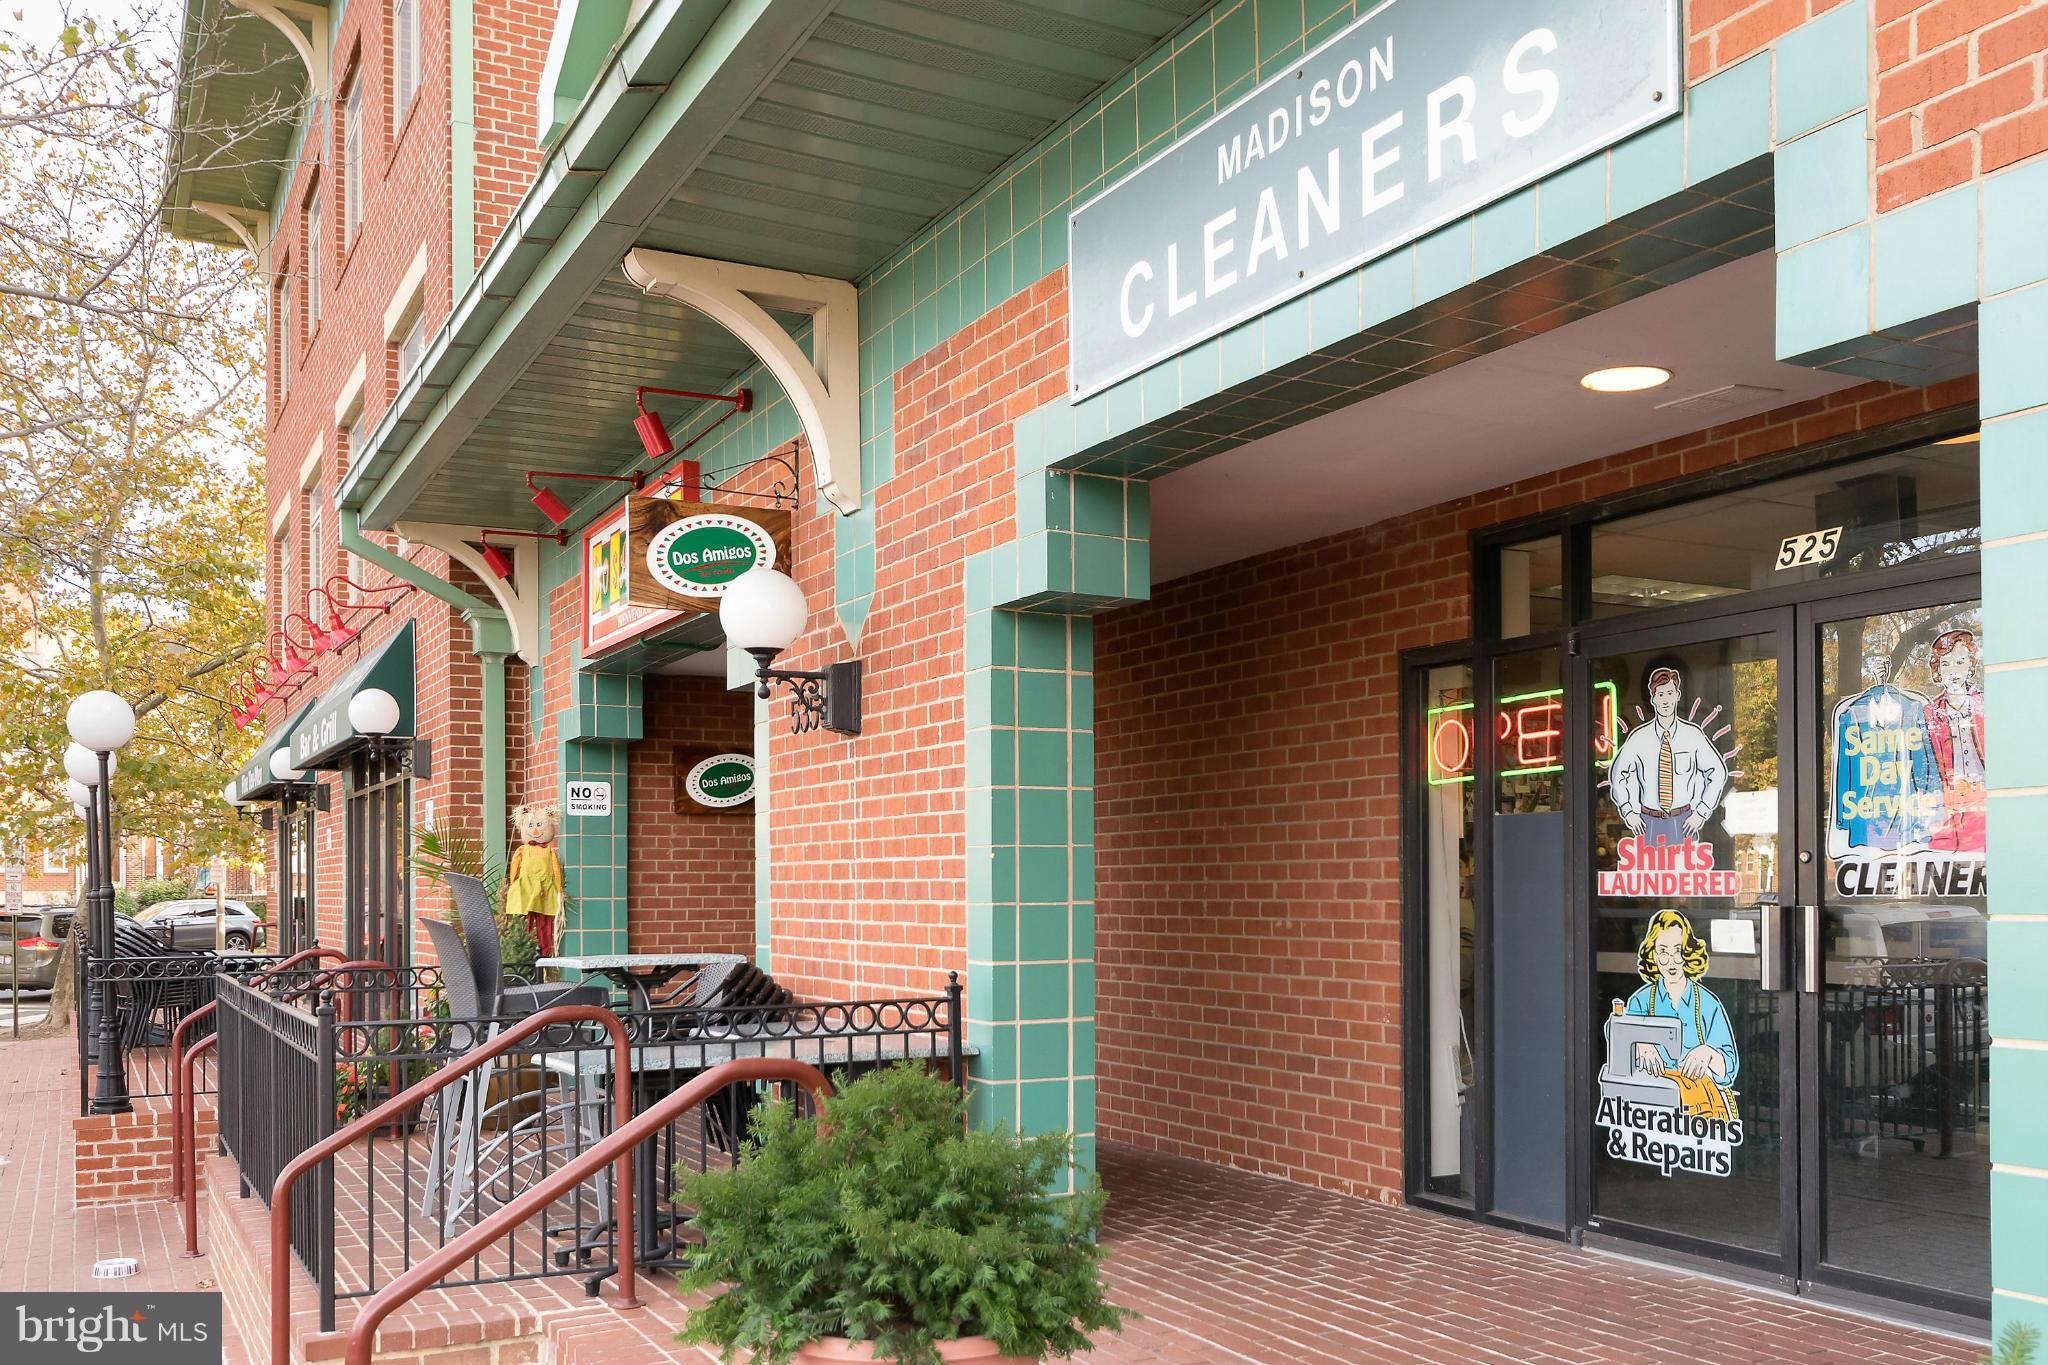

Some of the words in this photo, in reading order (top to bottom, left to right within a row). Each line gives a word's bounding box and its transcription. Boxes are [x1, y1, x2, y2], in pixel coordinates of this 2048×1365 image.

[1217, 35, 1394, 185] MADISON
[1119, 28, 1560, 338] CLEANERS
[672, 551, 699, 566] Dos
[702, 546, 752, 562] Amigos
[1779, 529, 1838, 566] 525
[300, 732, 311, 760] Bar
[312, 724, 319, 752] &
[321, 710, 337, 747] Grill
[1844, 725, 1923, 757] Same
[702, 777, 718, 788] Dos
[720, 772, 752, 785] Amigos
[1858, 756, 1913, 788] Day
[570, 787, 592, 798] NO
[570, 803, 607, 811] SMOKING
[1842, 790, 1937, 820] Service
[1617, 834, 1714, 871] Shirts
[1599, 872, 1742, 896] LAUNDERED
[1597, 1095, 1742, 1144] Alterations
[1608, 1128, 1627, 1157] &
[1632, 1131, 1730, 1175] Repairs
